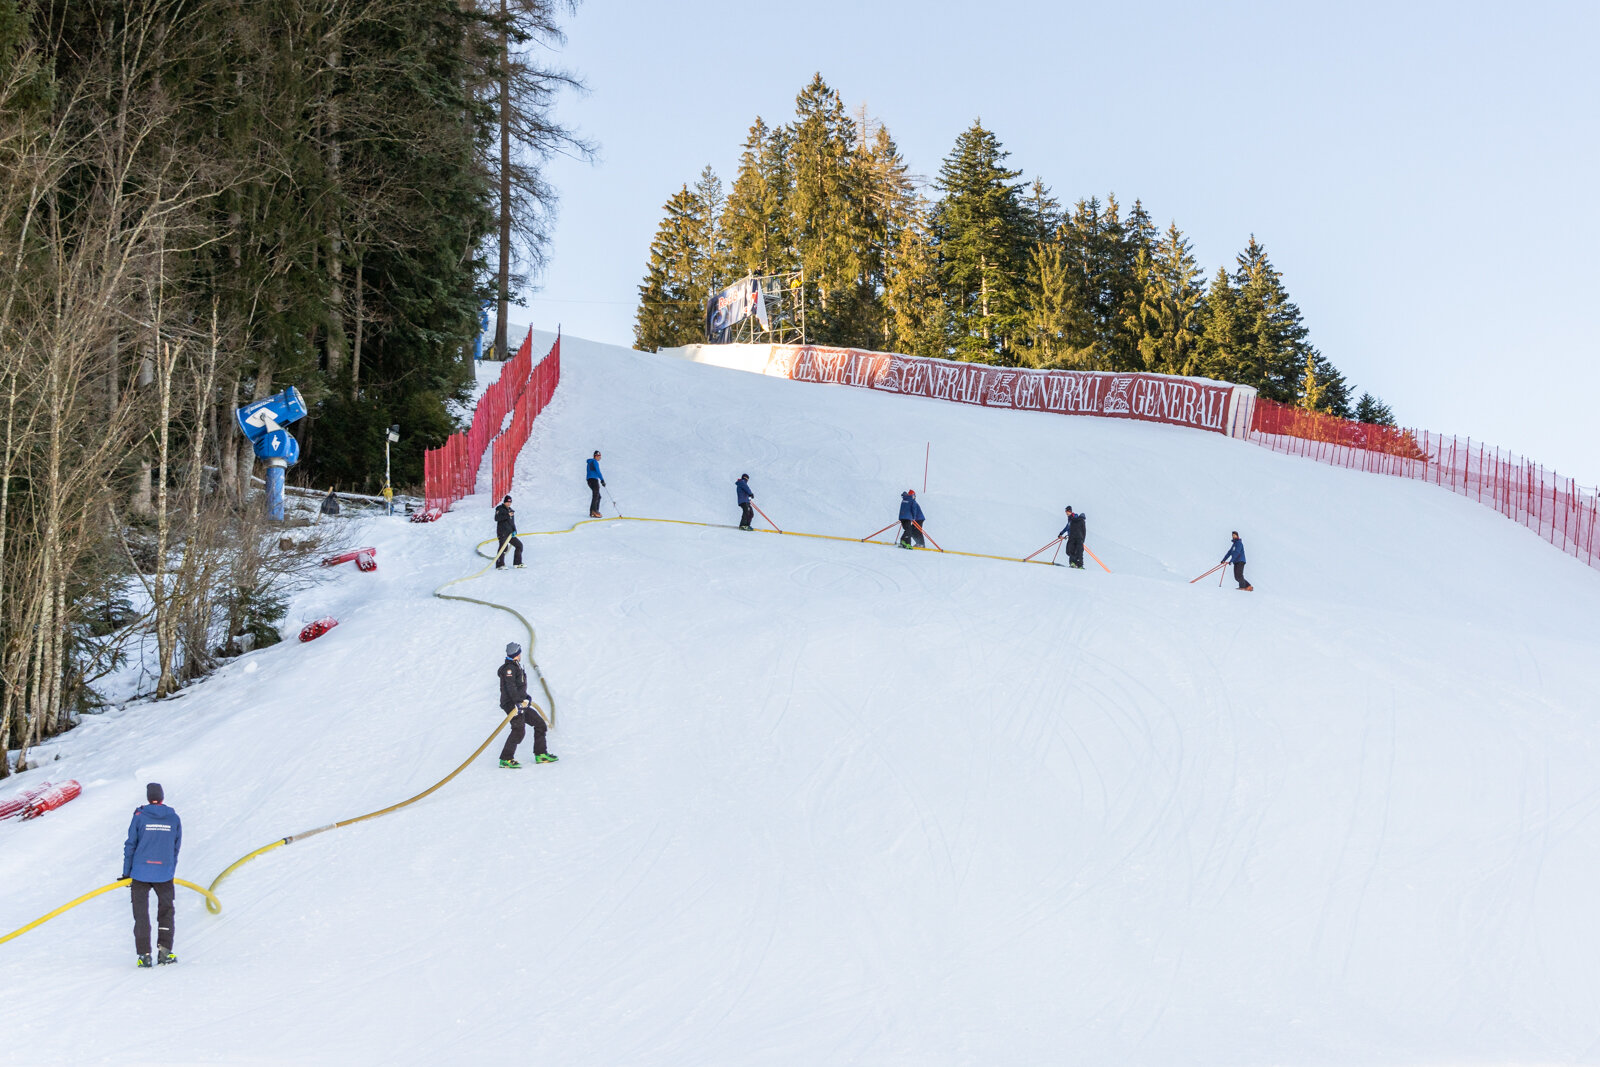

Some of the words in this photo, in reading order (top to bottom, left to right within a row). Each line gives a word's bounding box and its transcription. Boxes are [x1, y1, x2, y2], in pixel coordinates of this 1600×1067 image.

[793, 350, 873, 387] GENERALI
[901, 362, 987, 403] GENERALI
[1015, 374, 1102, 412] GENERALI
[1132, 378, 1228, 429] GENERALI
